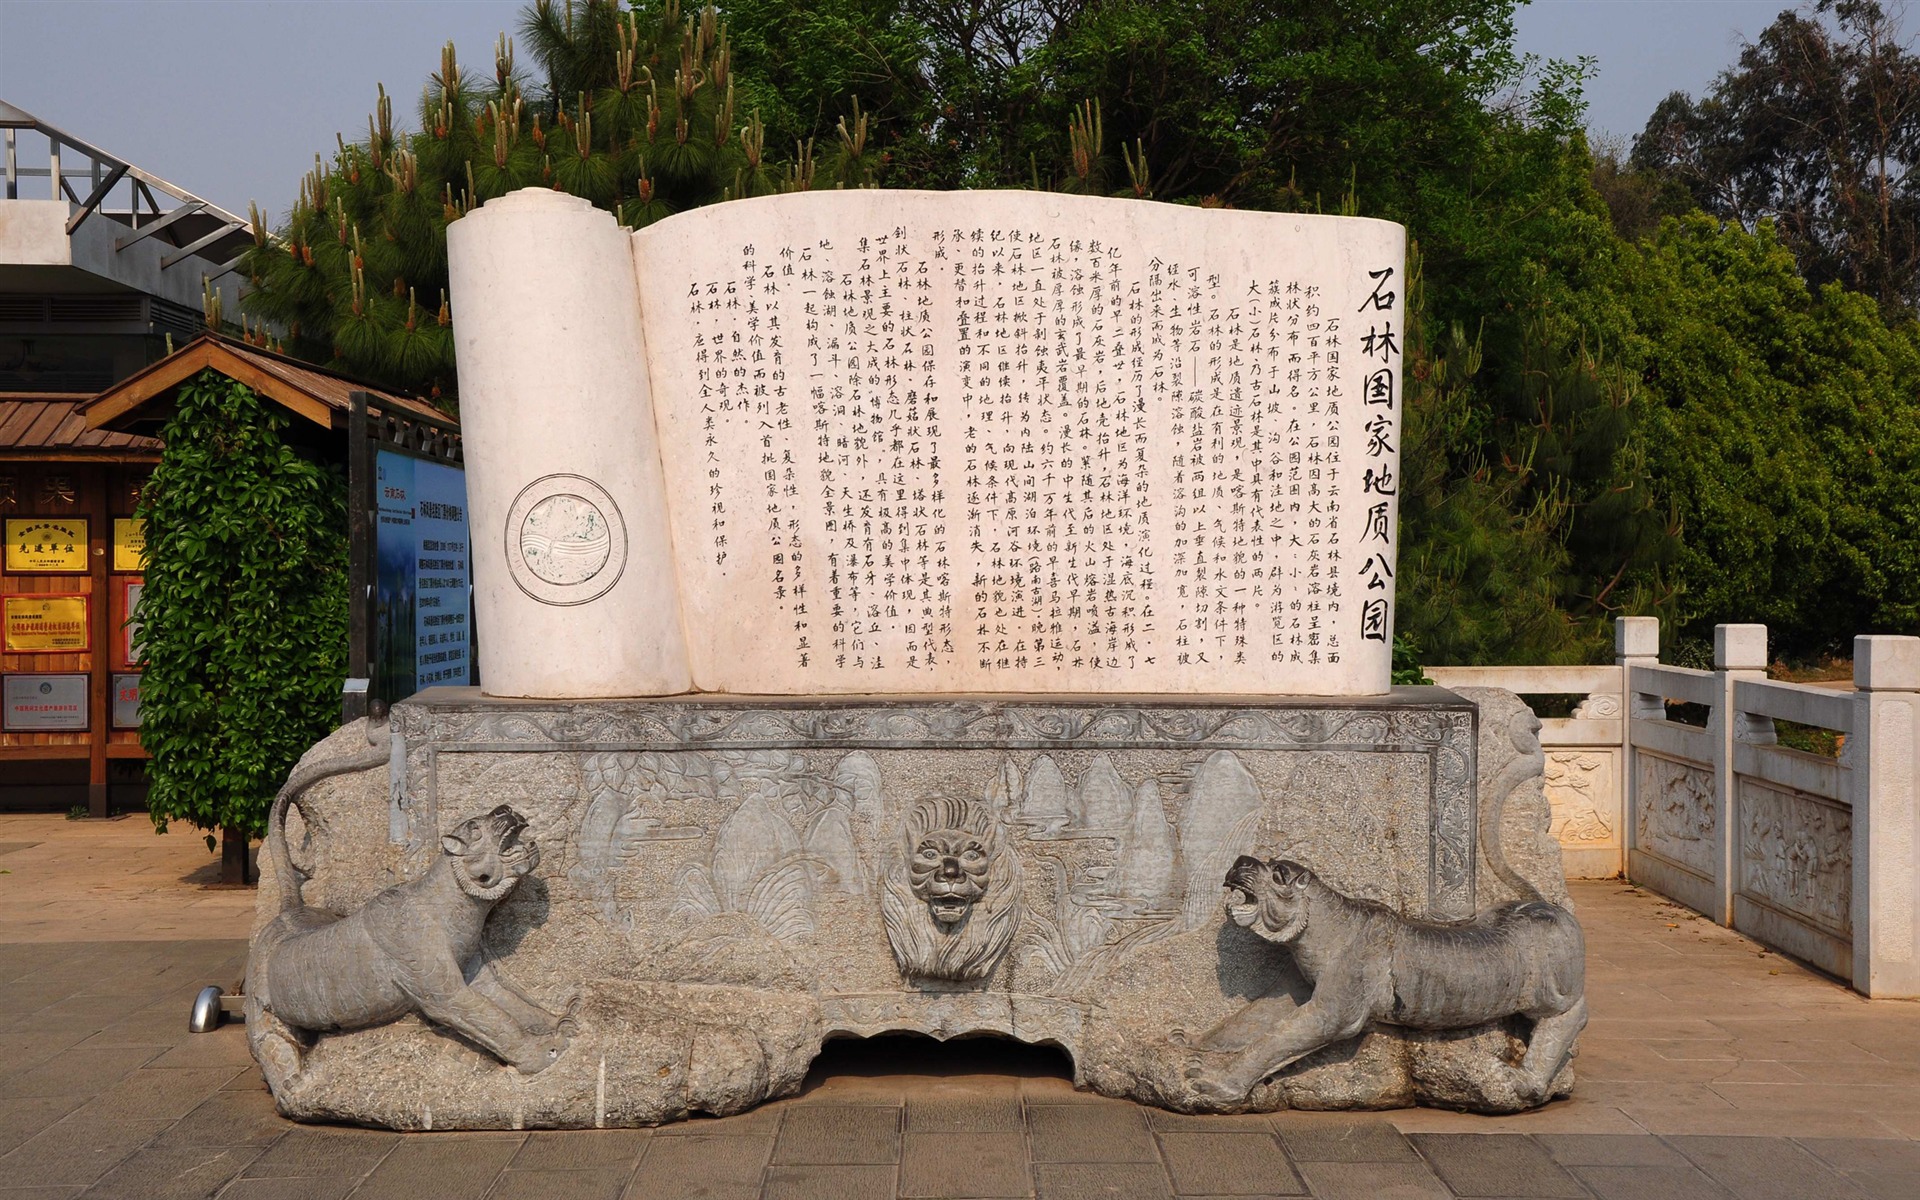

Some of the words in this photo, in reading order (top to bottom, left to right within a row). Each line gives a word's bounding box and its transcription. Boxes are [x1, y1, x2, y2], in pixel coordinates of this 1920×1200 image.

[1357, 266, 1400, 644] 石林国家地质公园
[119, 688, 142, 702] 文明
